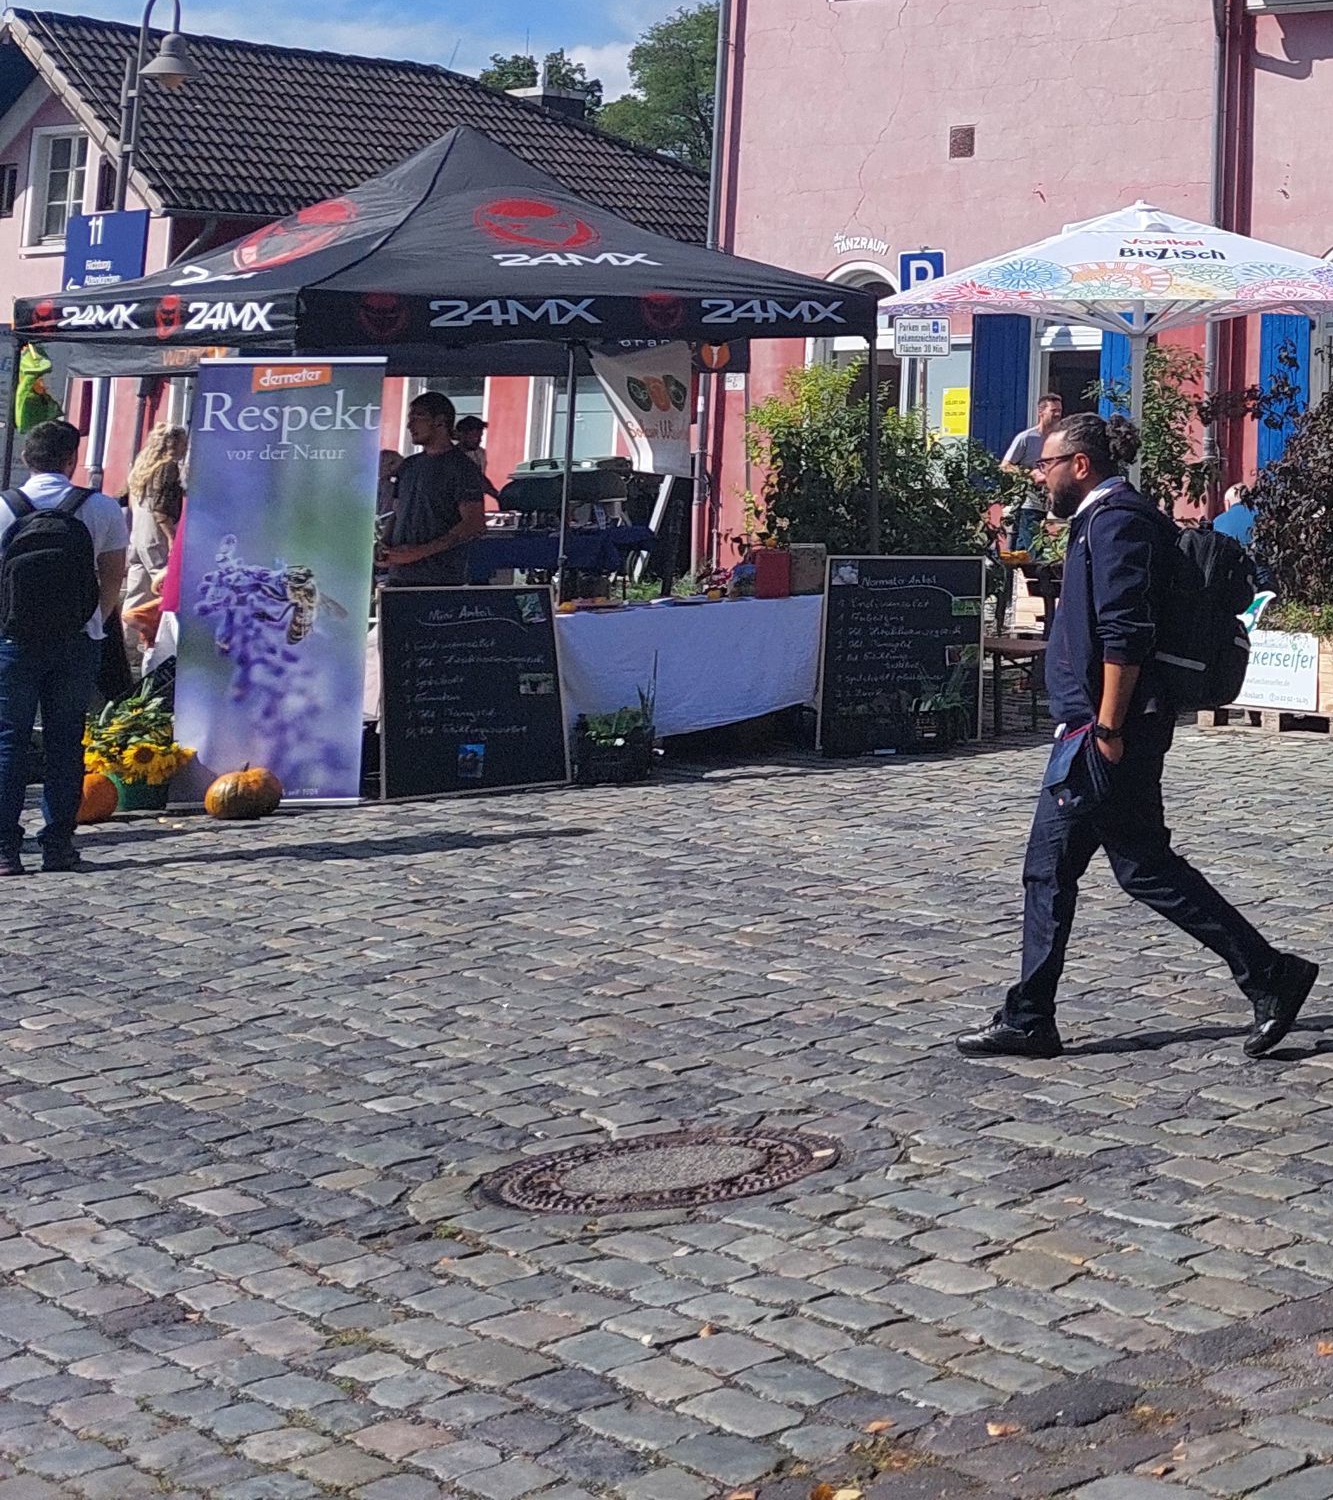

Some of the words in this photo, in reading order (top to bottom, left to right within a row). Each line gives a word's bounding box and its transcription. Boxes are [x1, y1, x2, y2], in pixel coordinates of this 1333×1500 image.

[88, 215, 104, 246] 11
[834, 236, 890, 256] TANZRAUM
[491, 252, 663, 267] 24MX
[909, 259, 935, 289] P
[184, 301, 275, 331] 24MX
[429, 300, 603, 328] 24MX
[701, 301, 848, 324] 24MX
[899, 321, 920, 332] Parken
[921, 321, 931, 332] mit
[940, 322, 947, 332] in
[898, 333, 948, 344] gekennzeichneten
[900, 343, 922, 354] Flächen
[924, 343, 932, 353] 30
[933, 343, 946, 353] Min.
[259, 368, 323, 387] demeter
[198, 389, 382, 445] Respekt
[226, 449, 254, 461] vor
[259, 444, 288, 461] der
[293, 444, 346, 461] Natur
